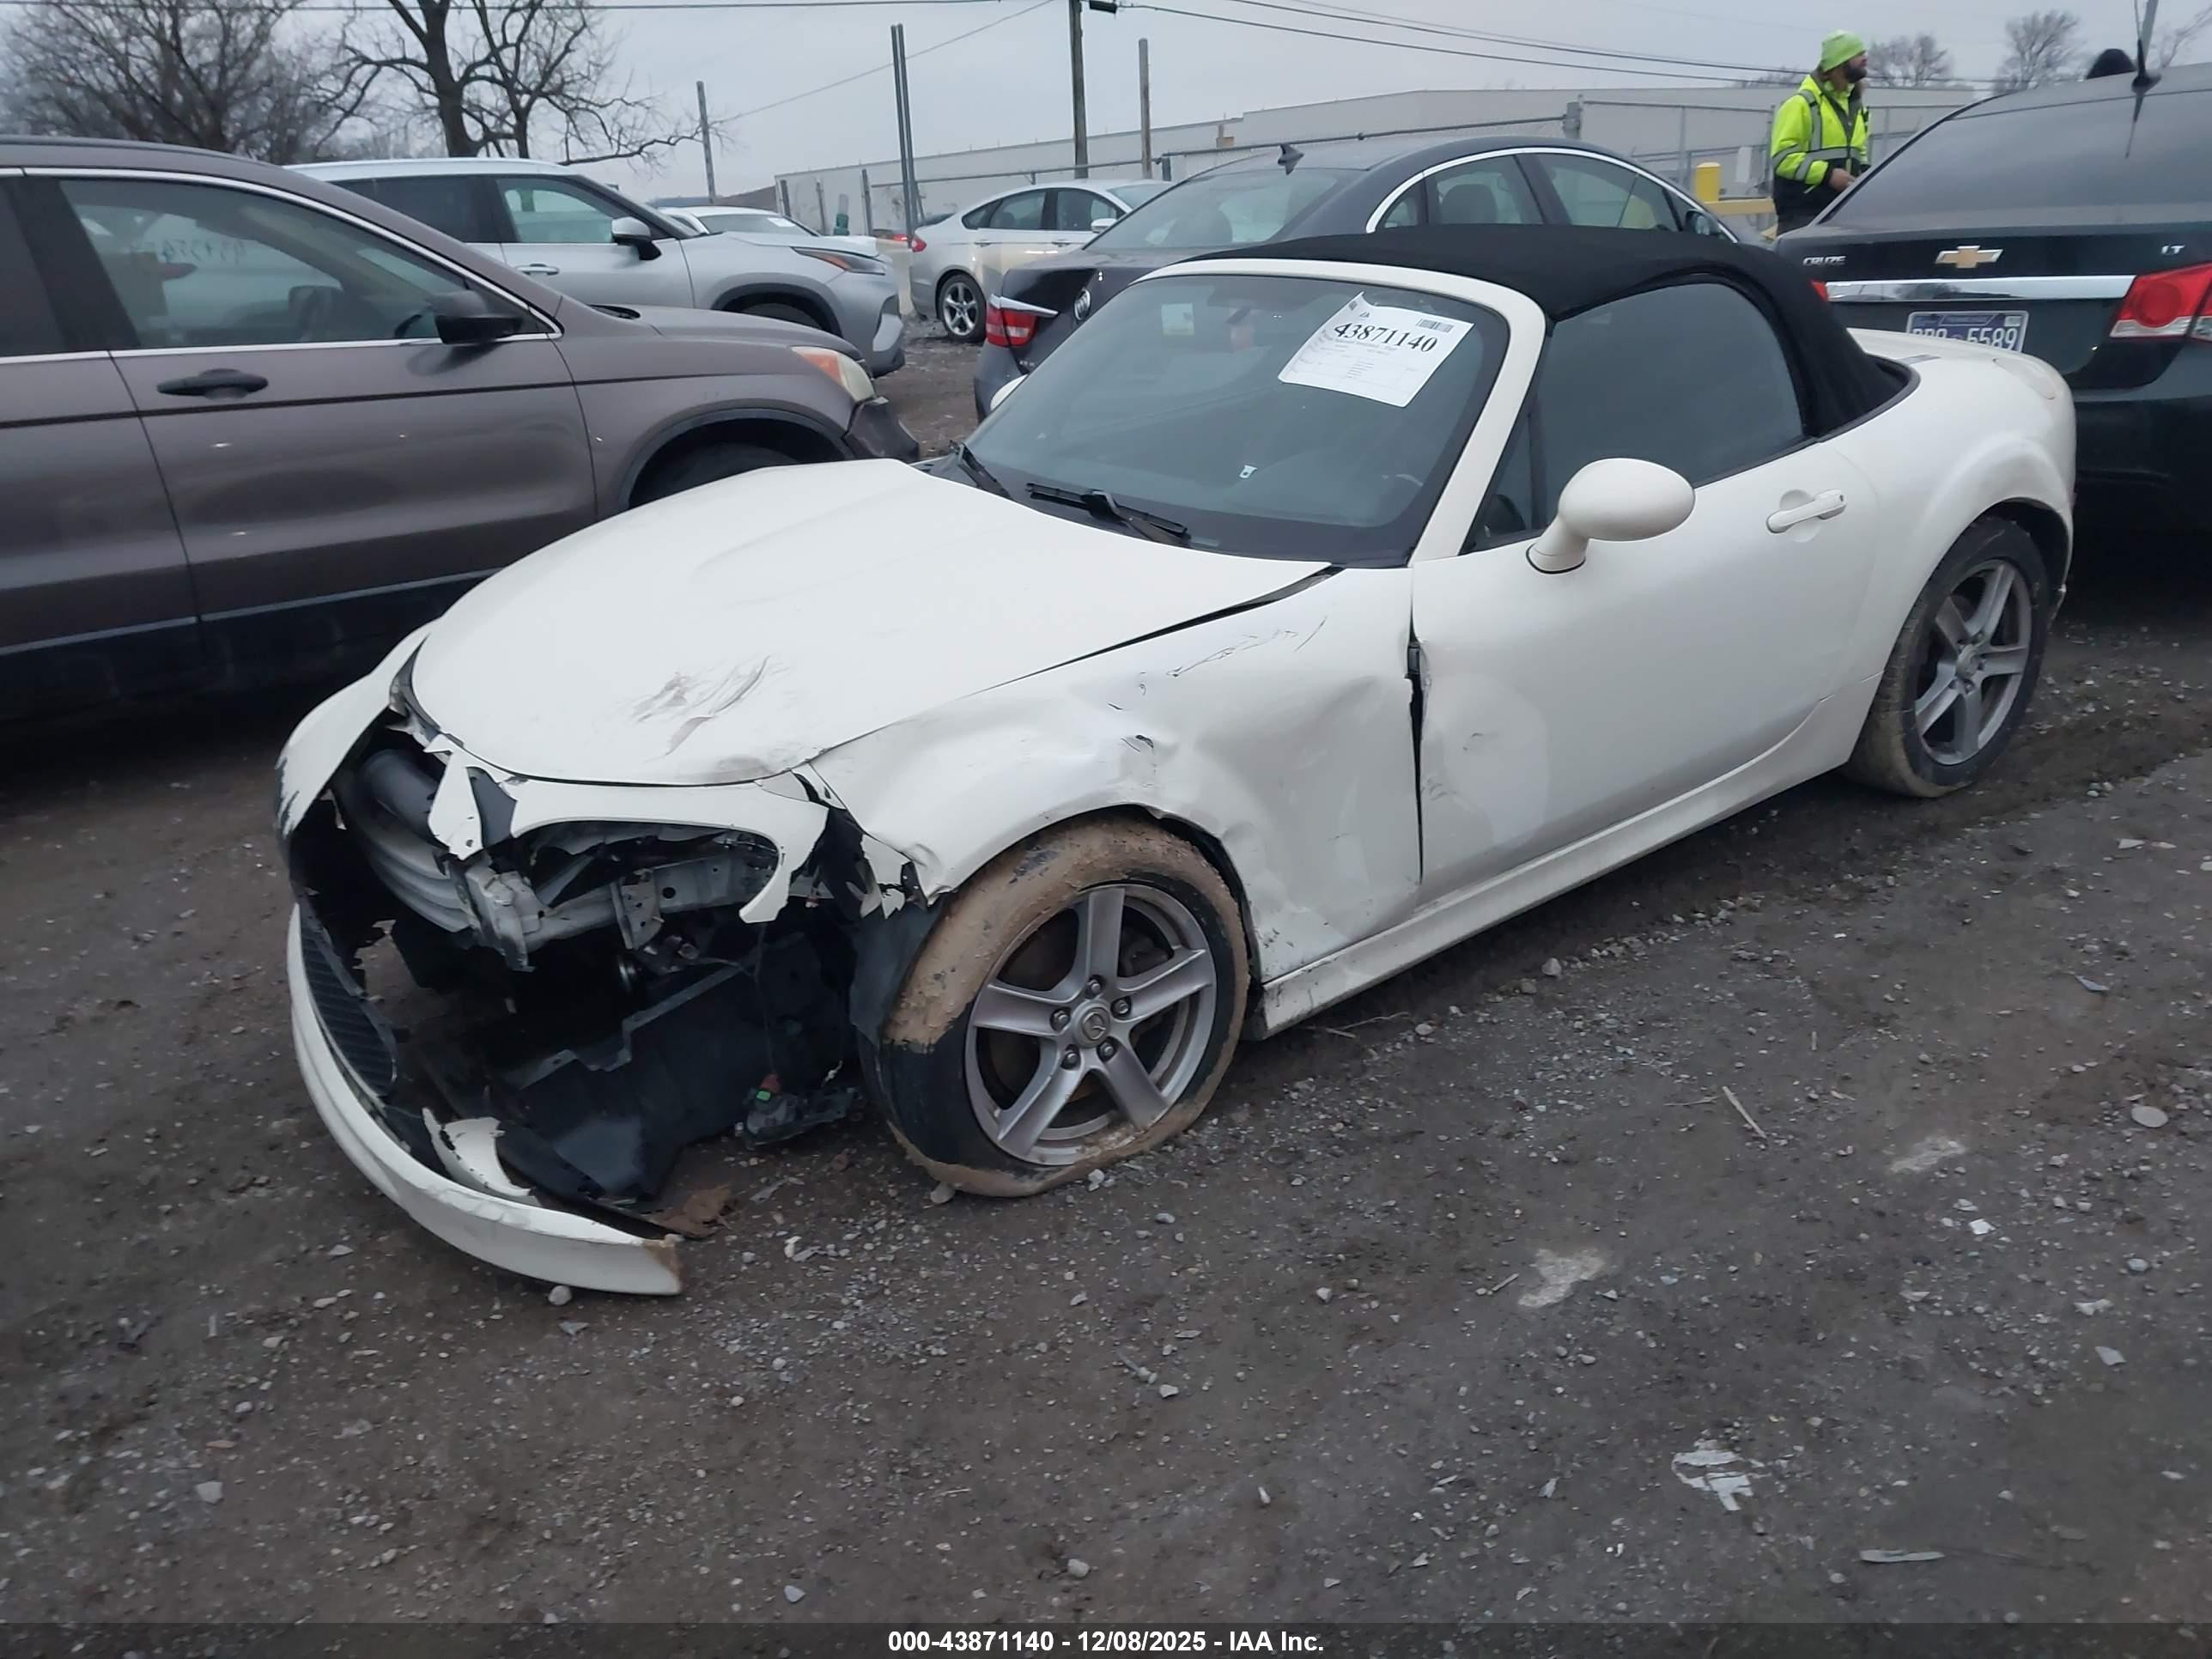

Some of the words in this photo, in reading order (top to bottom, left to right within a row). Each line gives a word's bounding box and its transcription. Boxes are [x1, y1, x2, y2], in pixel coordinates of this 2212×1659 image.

[1802, 255, 1846, 266] CRUZE
[1334, 323, 1438, 352] 43871140
[1966, 327, 2018, 350] 5589
